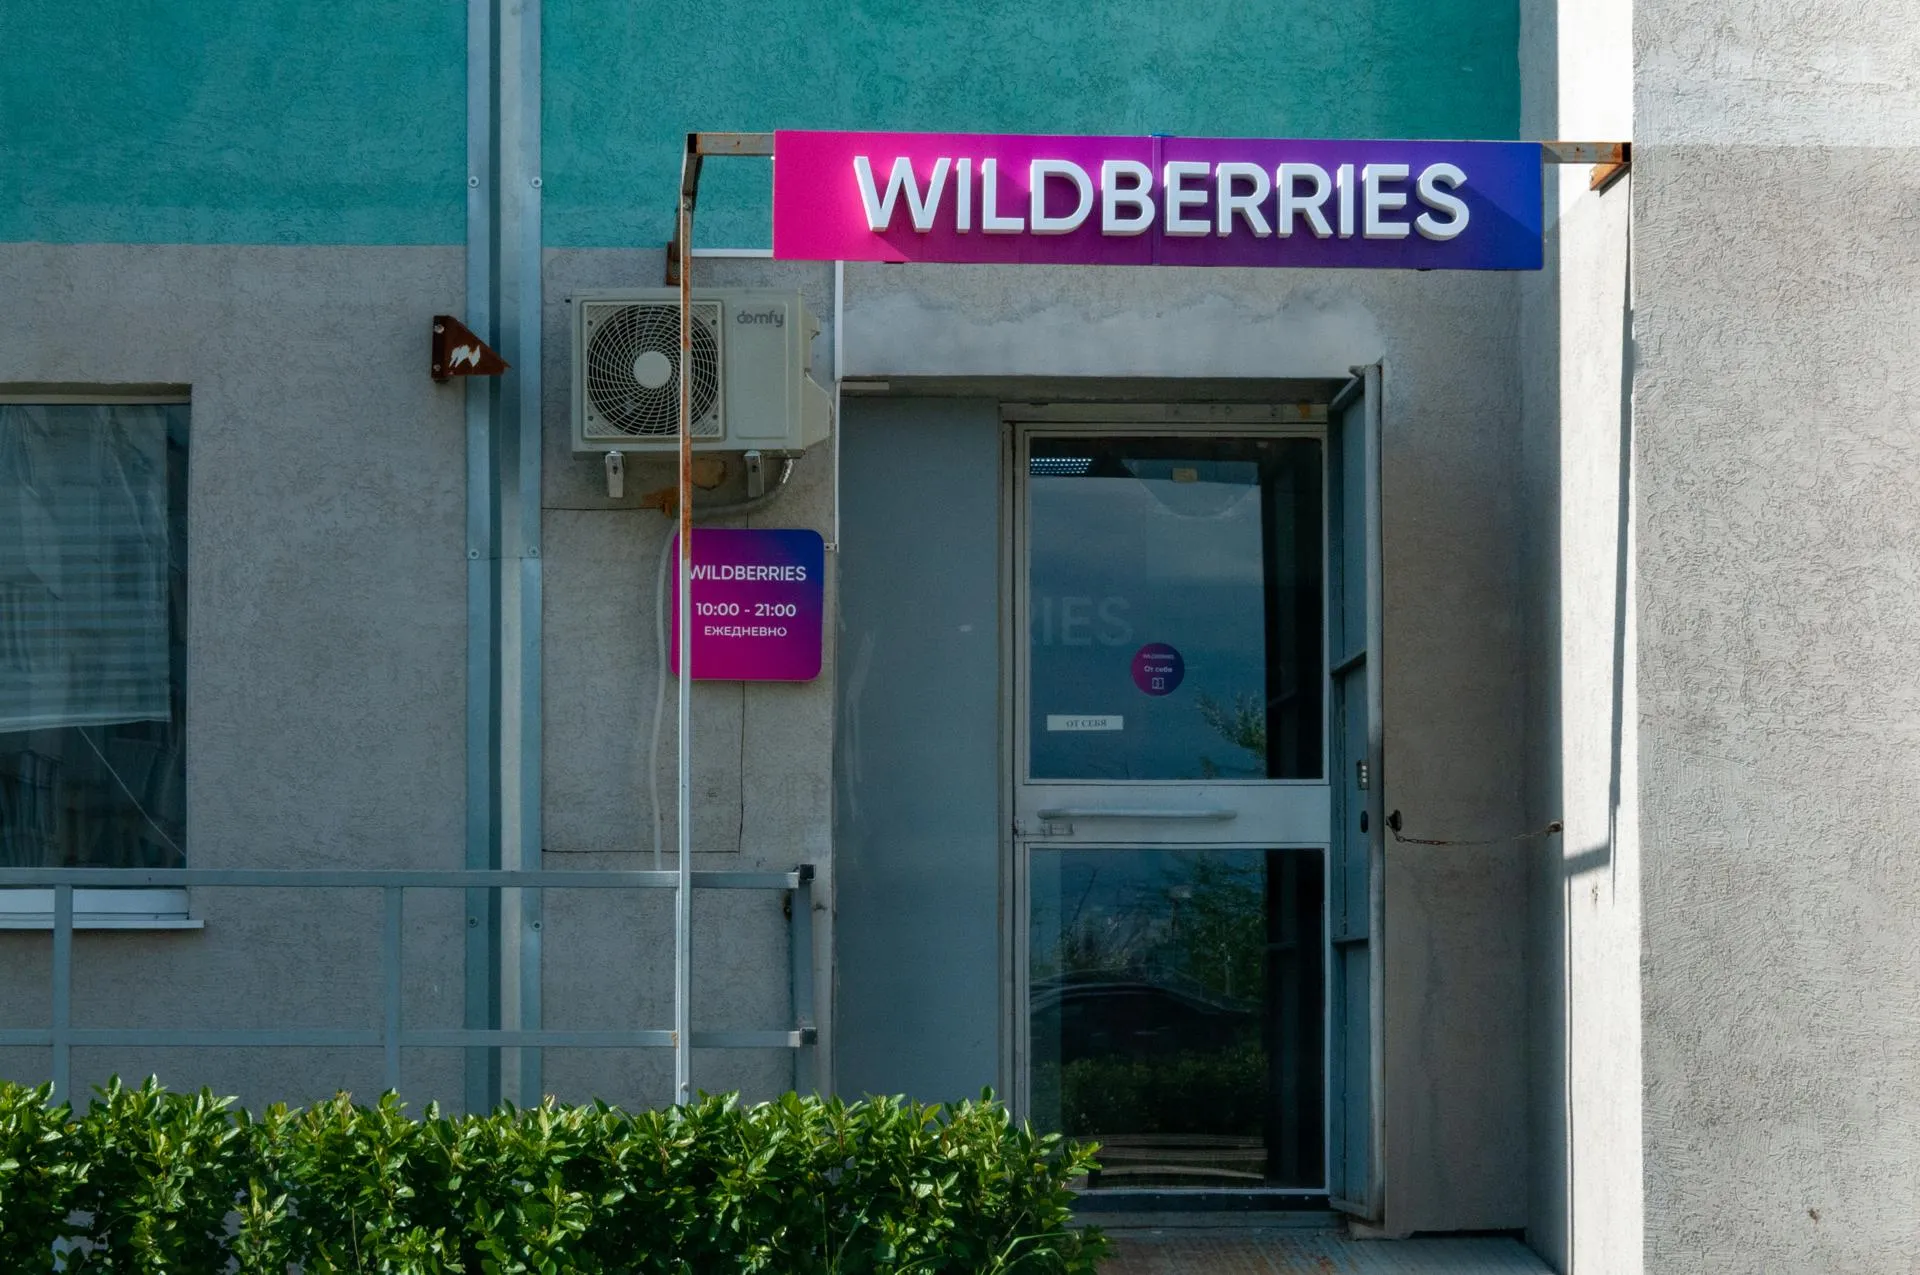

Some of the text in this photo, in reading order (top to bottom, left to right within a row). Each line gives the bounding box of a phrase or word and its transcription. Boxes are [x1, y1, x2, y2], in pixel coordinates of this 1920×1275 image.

[853, 155, 1470, 241] WILDBERRIES
[736, 310, 784, 328] domfy
[690, 565, 807, 581] WILDBERRIES
[696, 602, 740, 616] 10:00
[754, 603, 797, 617] 21:00
[704, 626, 788, 638] ЕЖЕДНЕВНО
[1066, 719, 1079, 729] ОТ
